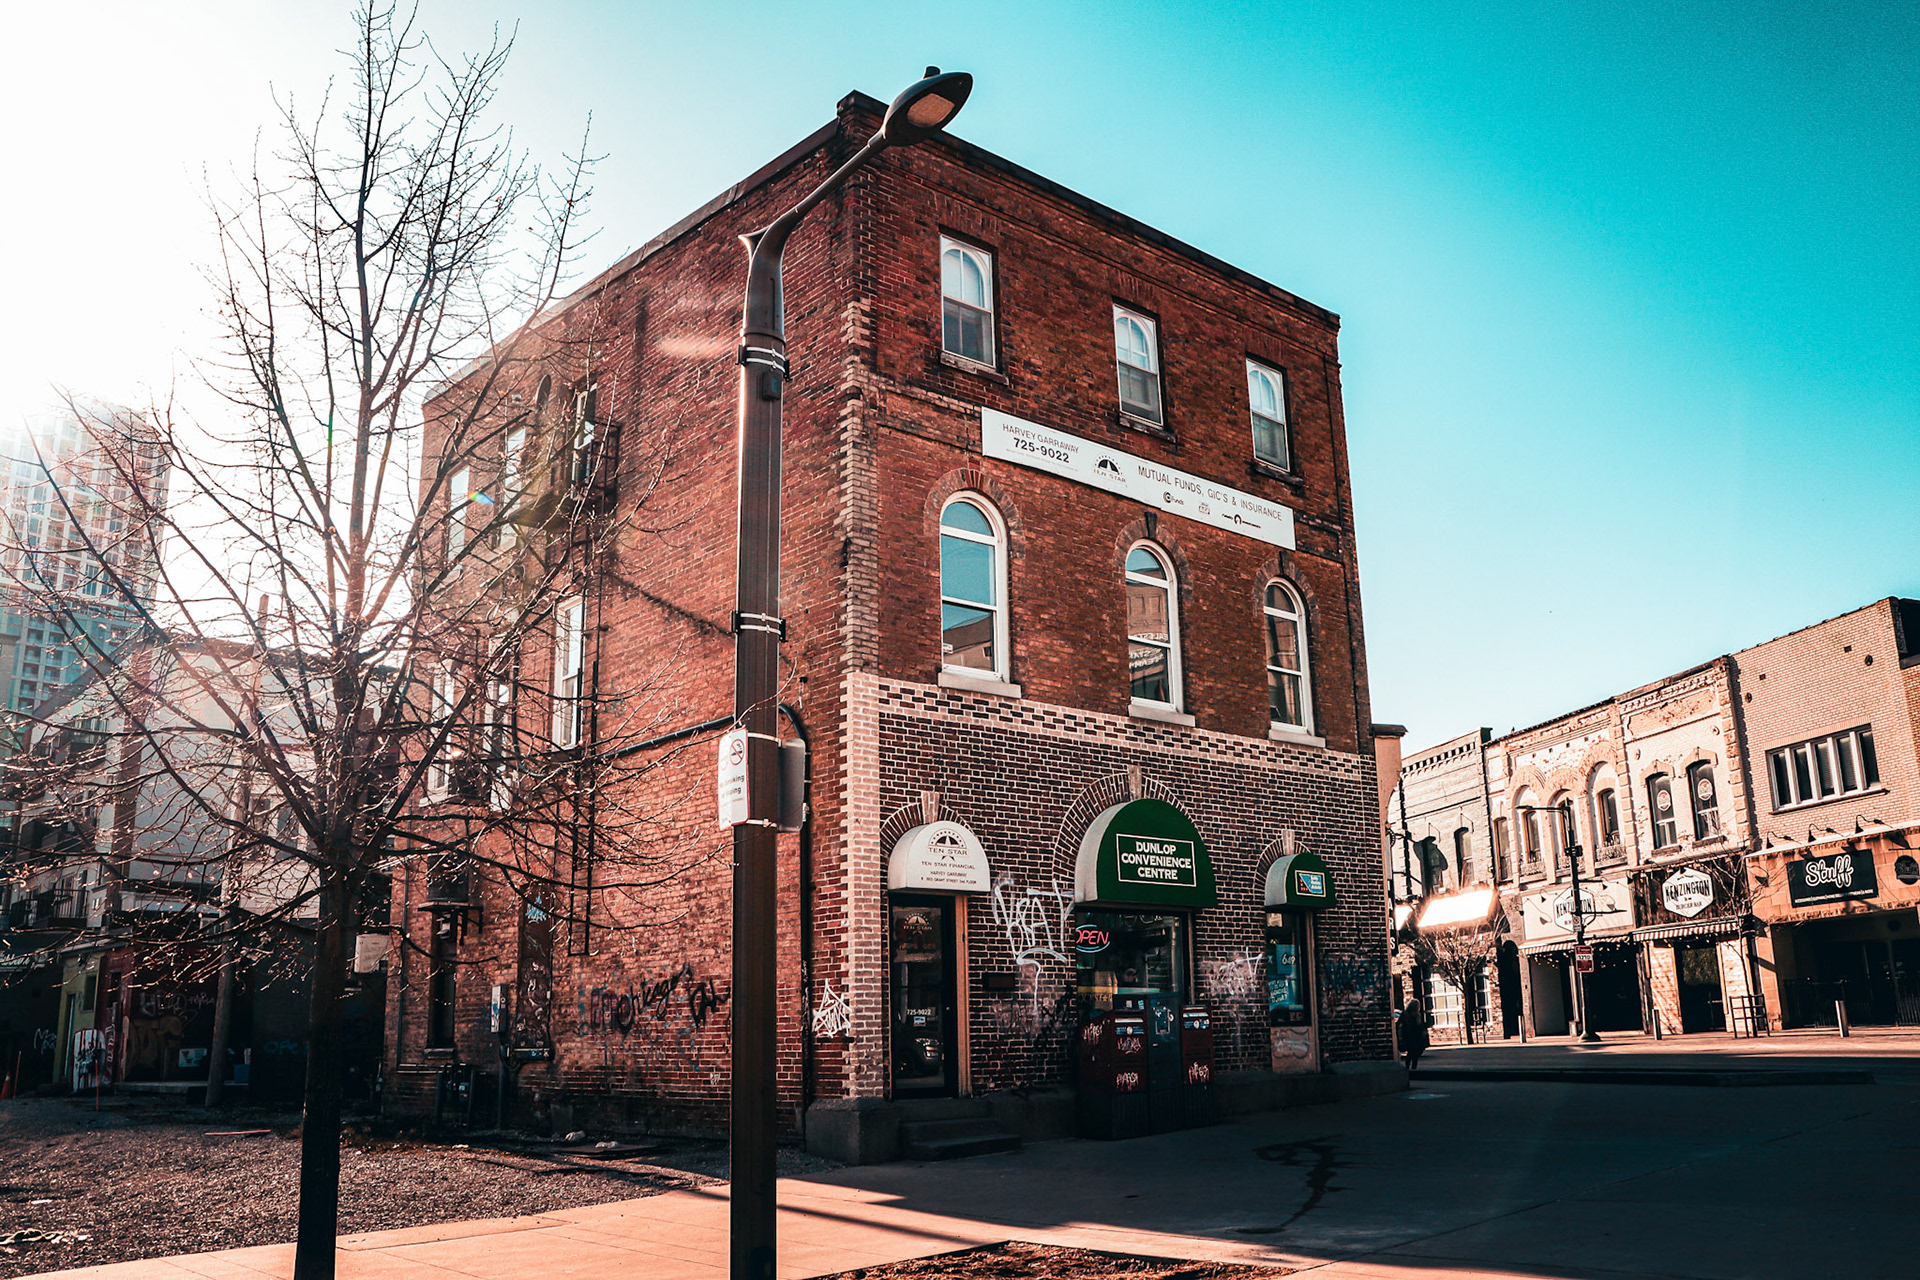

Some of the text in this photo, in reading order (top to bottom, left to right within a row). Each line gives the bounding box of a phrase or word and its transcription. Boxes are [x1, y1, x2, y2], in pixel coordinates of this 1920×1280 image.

[1002, 424, 1080, 454] HARVEY GARRAWAY
[1013, 437, 1070, 464] 725-9022
[1109, 473, 1126, 483] STAR
[1138, 466, 1172, 486] MUTUAL
[1208, 488, 1228, 504] GIC'S
[1232, 496, 1237, 506] &
[1240, 500, 1282, 521] INSURANCE
[1136, 841, 1176, 855] DUNLOP
[1121, 852, 1192, 868] CONVENIENCE
[1805, 854, 1854, 888] Stuff
[1138, 866, 1178, 880] CENTRE
[1664, 880, 1710, 902] KENZINGTON
